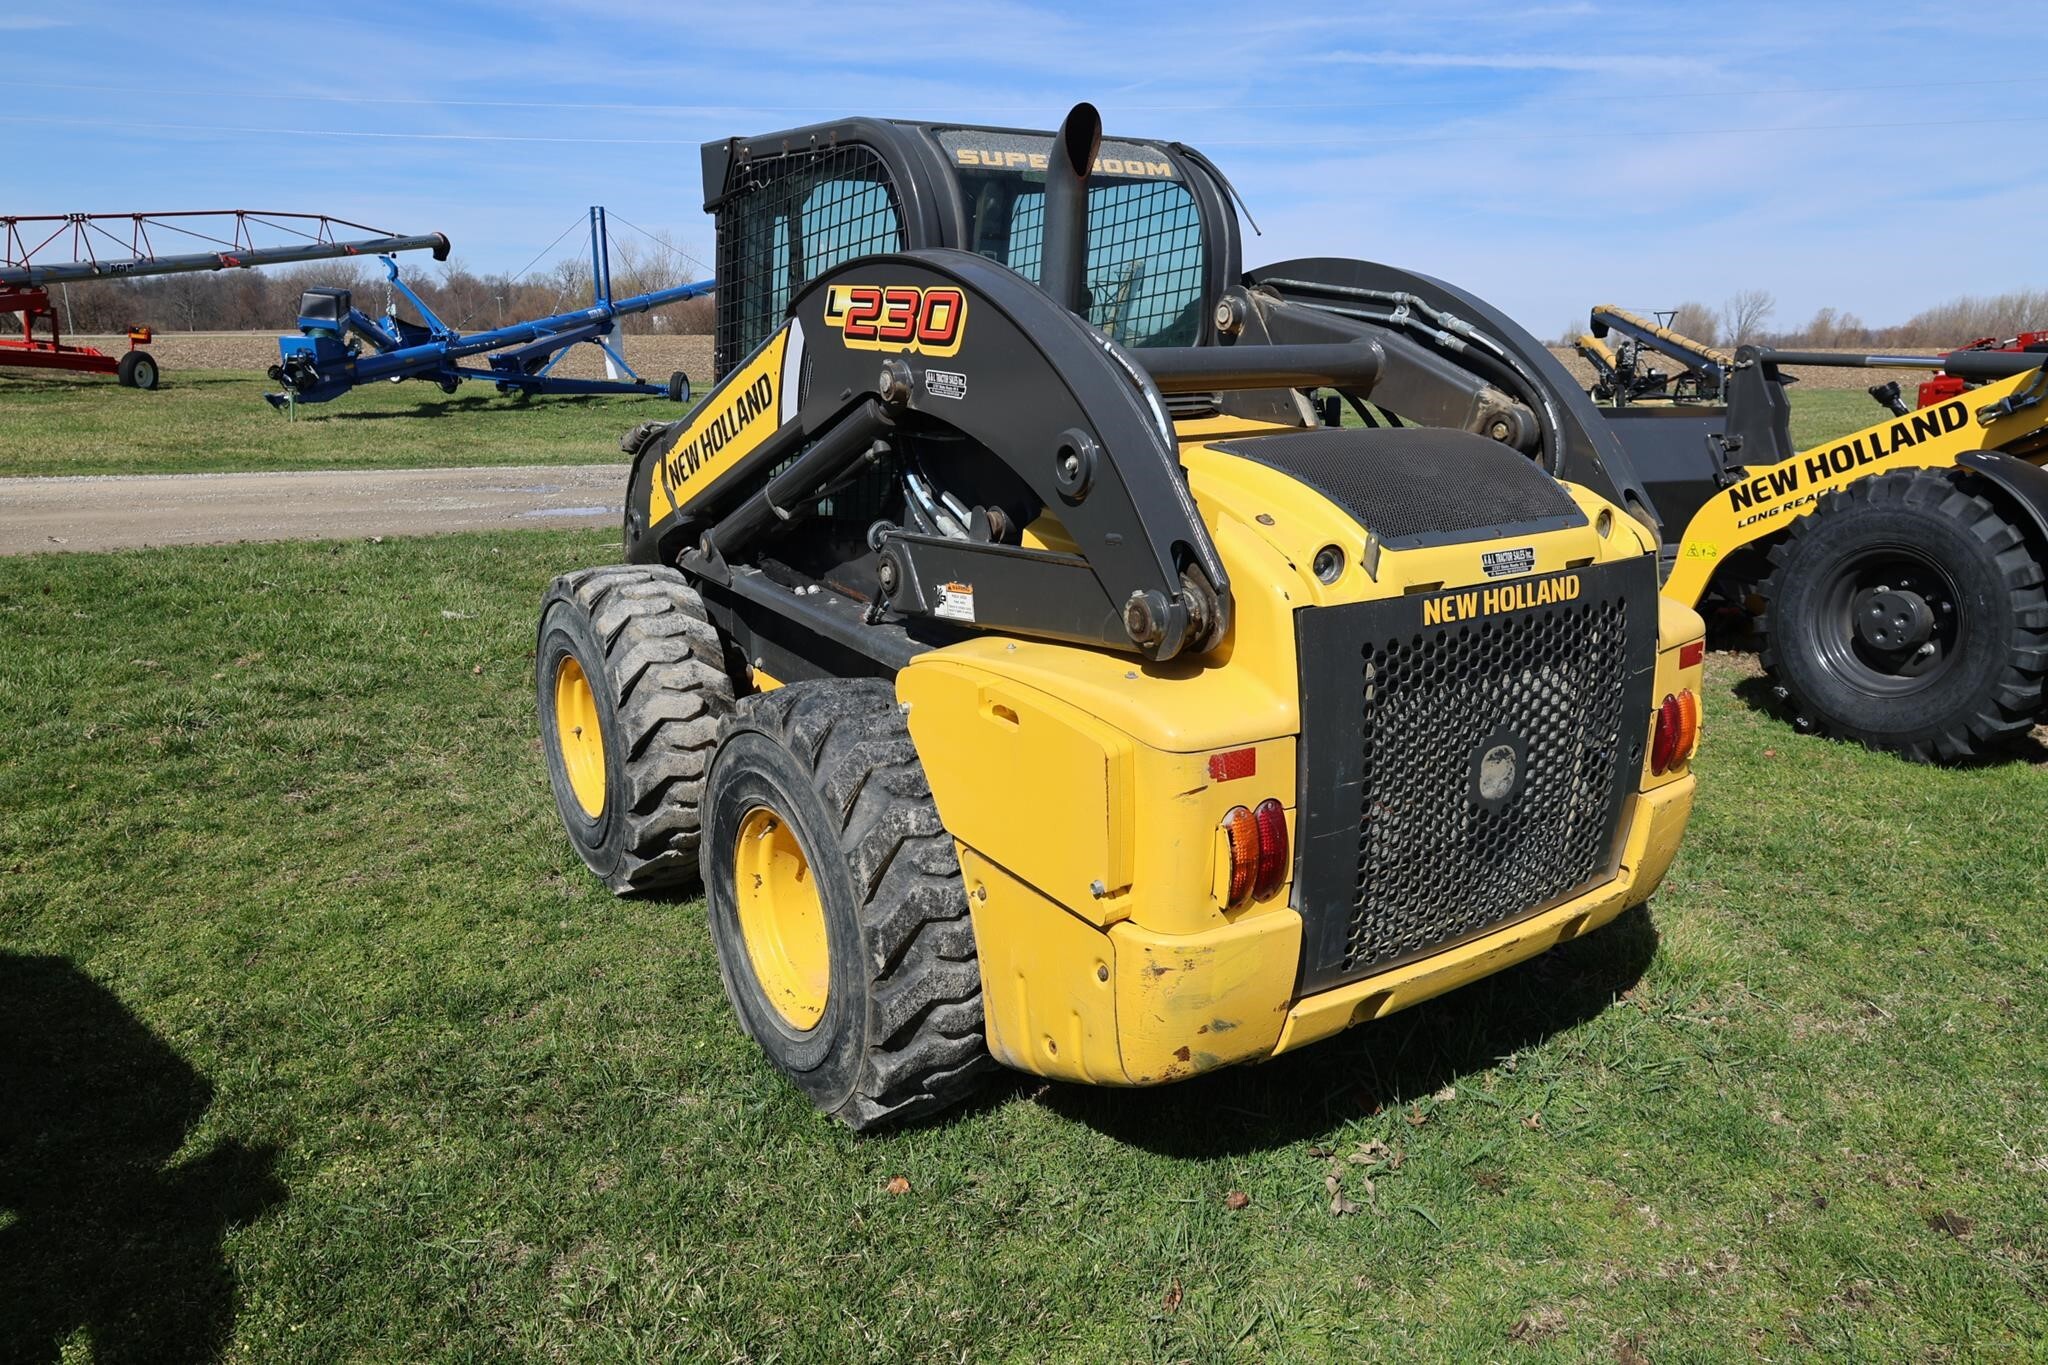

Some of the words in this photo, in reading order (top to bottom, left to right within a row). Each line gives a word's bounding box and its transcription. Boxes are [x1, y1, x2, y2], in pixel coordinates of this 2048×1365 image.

[957, 149, 1049, 169] SUPE
[826, 287, 964, 347] L230
[668, 440, 701, 491] NEW
[700, 373, 773, 463] HOLLAND
[1729, 464, 1798, 513] NEW
[1805, 401, 1969, 484] HOLLAND
[1737, 507, 1780, 529] LONG
[1495, 551, 1513, 563] TRACTOR
[1513, 549, 1526, 561] SALES
[1423, 591, 1478, 627] NEW
[1483, 575, 1580, 616] HOLLAND
